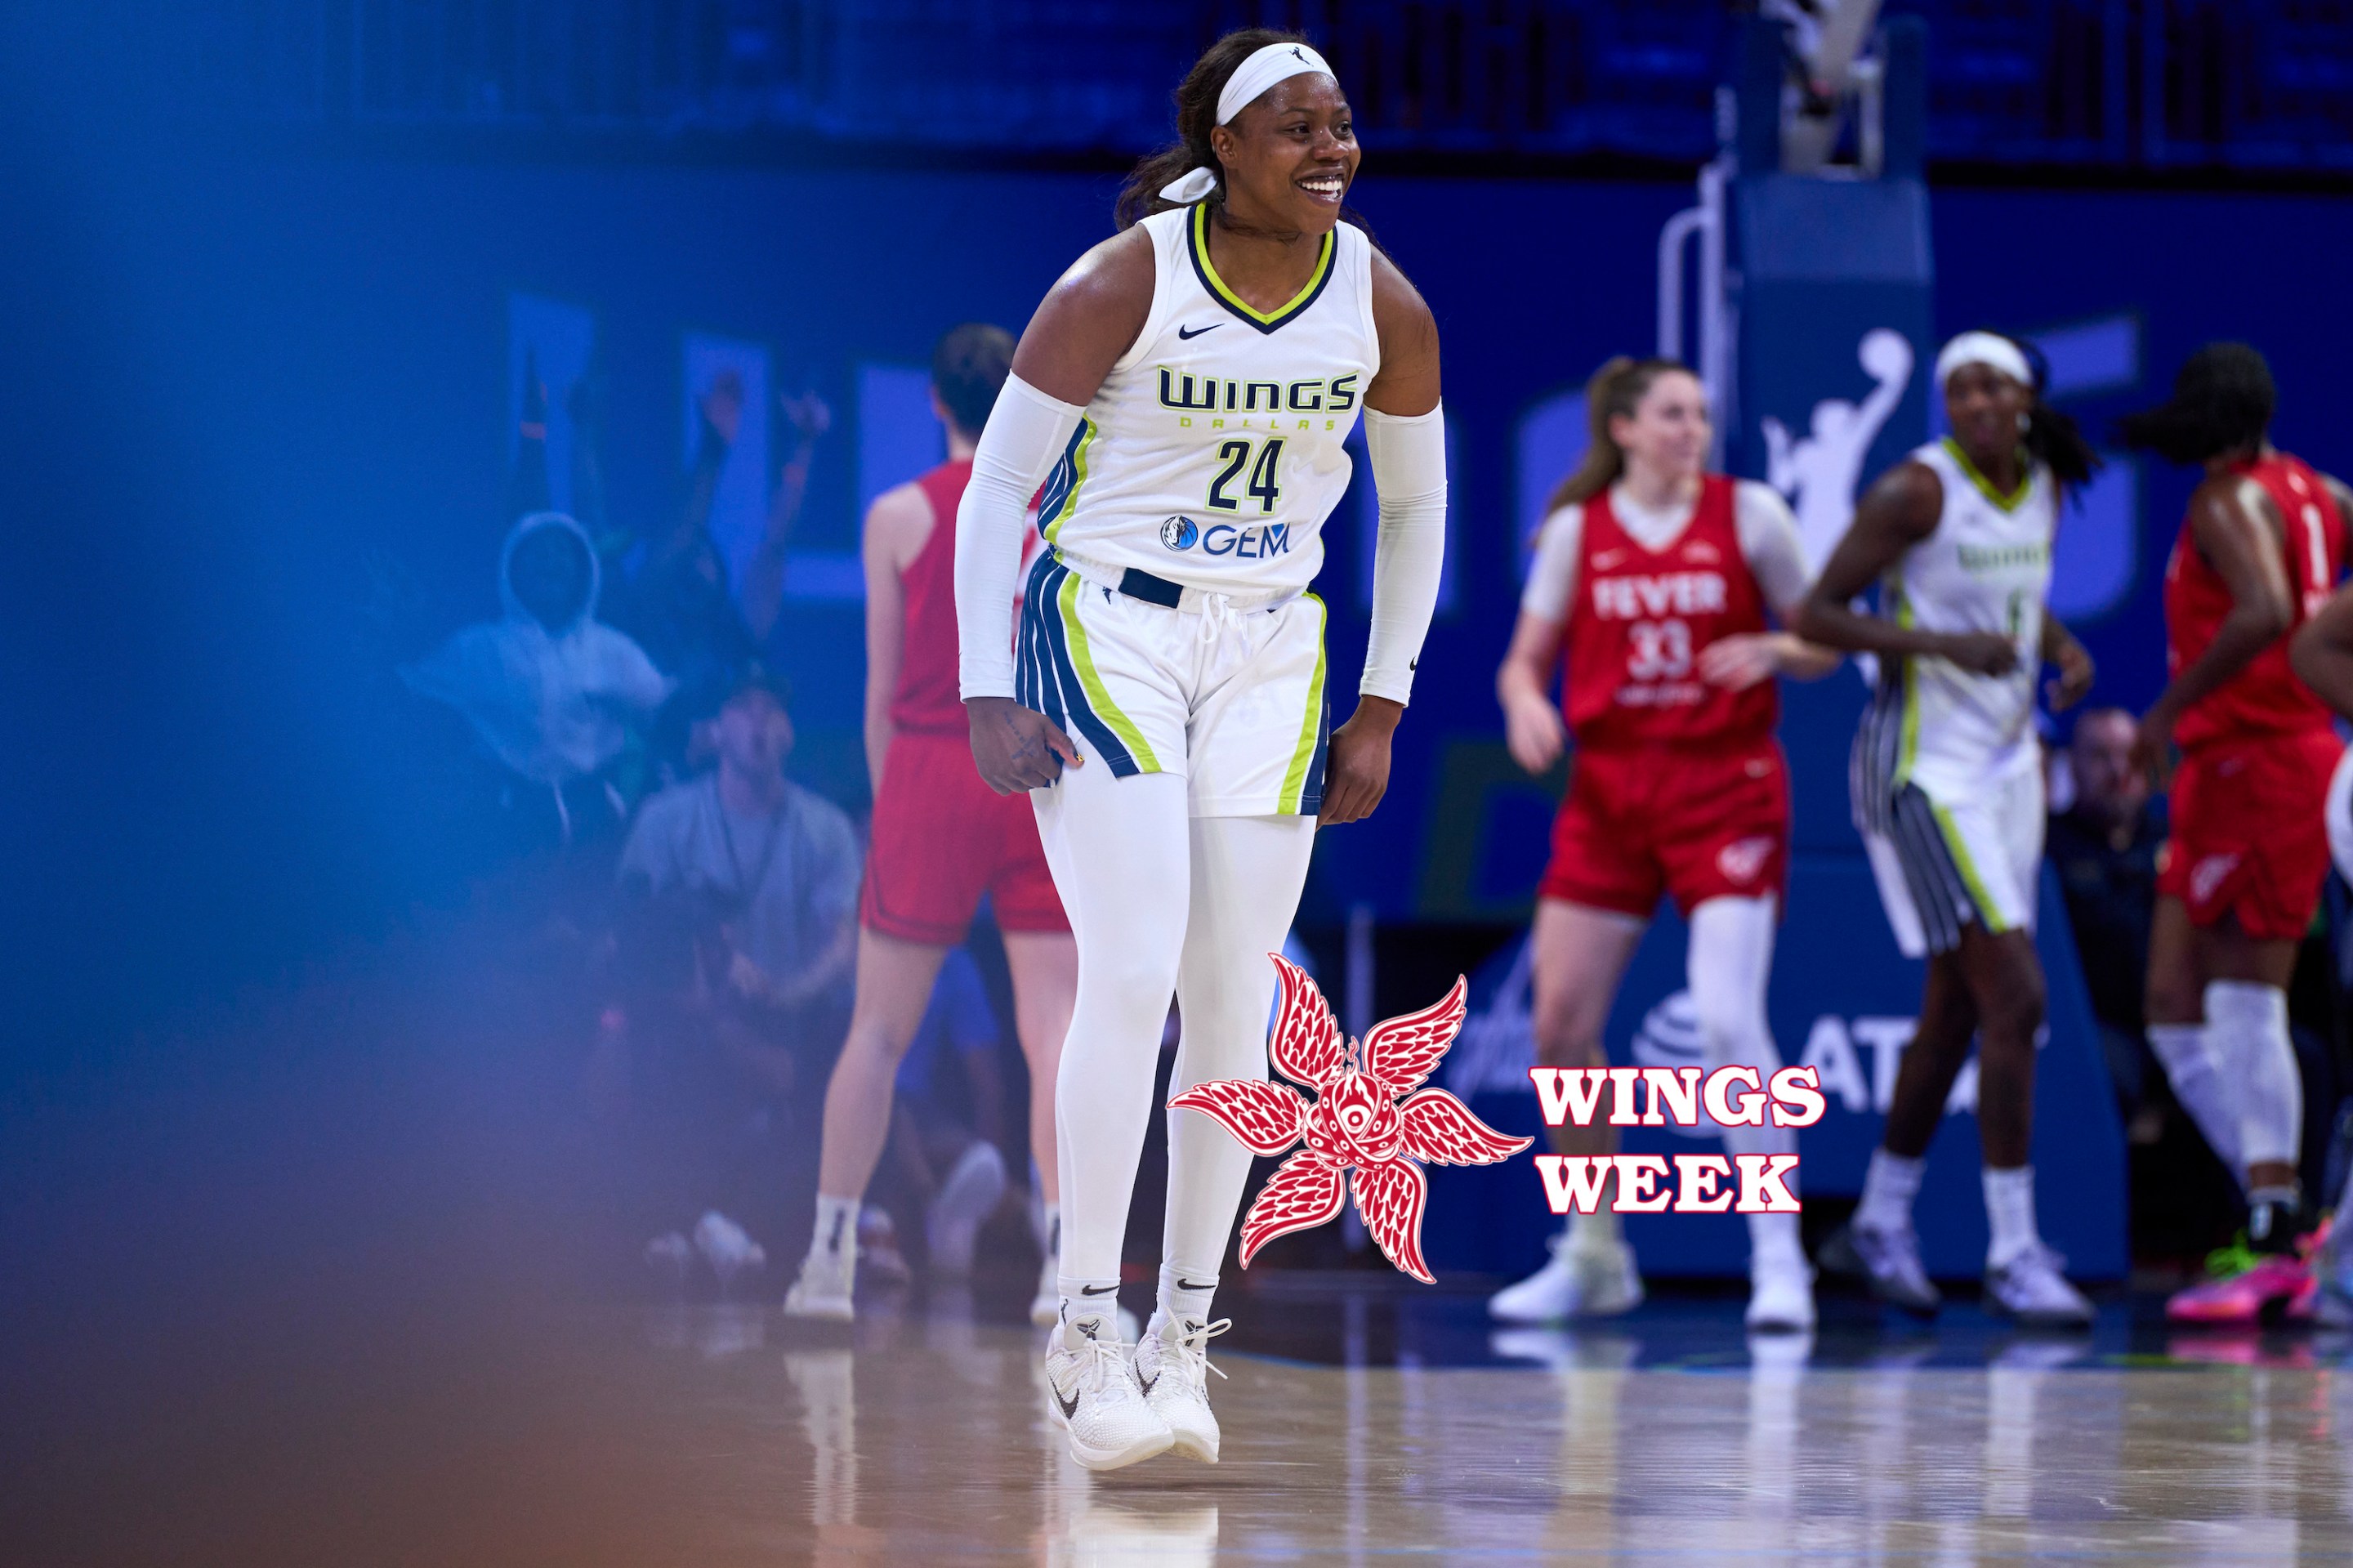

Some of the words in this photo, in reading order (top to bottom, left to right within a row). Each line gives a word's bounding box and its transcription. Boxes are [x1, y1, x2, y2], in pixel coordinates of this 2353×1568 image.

[1158, 364, 1360, 414] WINGS
[1180, 417, 1336, 431] DALLAS
[1205, 436, 1288, 516] 24
[1592, 572, 1726, 619] FEVER
